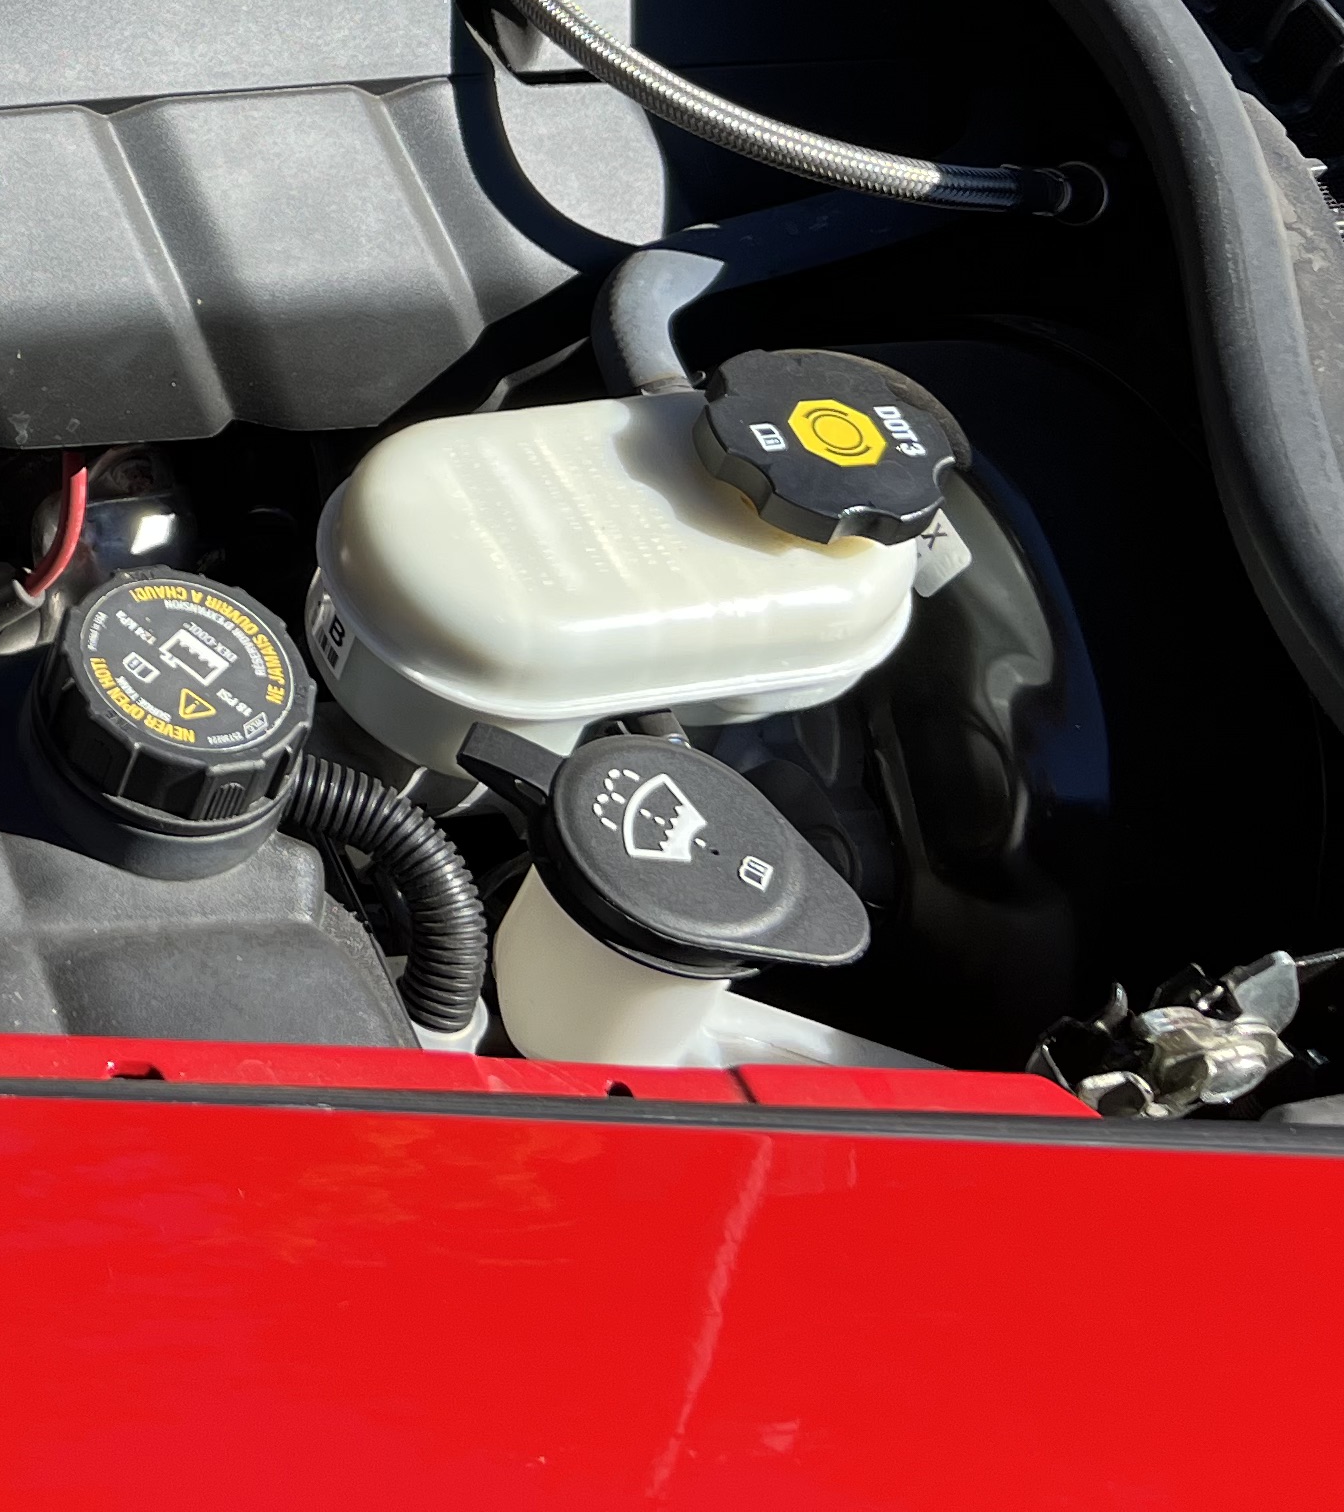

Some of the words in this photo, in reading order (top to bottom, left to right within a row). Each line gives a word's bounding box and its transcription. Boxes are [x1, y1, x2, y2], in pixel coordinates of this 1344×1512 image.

[873, 405, 918, 443] DOT
[899, 441, 927, 458] 3
[128, 584, 187, 604] CHAUD!
[114, 609, 140, 632] kPa
[203, 593, 258, 636] OUVRIR
[134, 625, 157, 646] 124
[328, 614, 346, 648] B
[252, 632, 286, 686] JAMAIS
[89, 657, 118, 694] HOT!
[114, 673, 141, 701] TANK
[107, 686, 145, 723] OPEN
[215, 687, 239, 706] PSI
[265, 682, 286, 705] NE
[136, 696, 172, 724] SURGE
[236, 701, 252, 717] 18
[143, 709, 196, 744] NEVER
